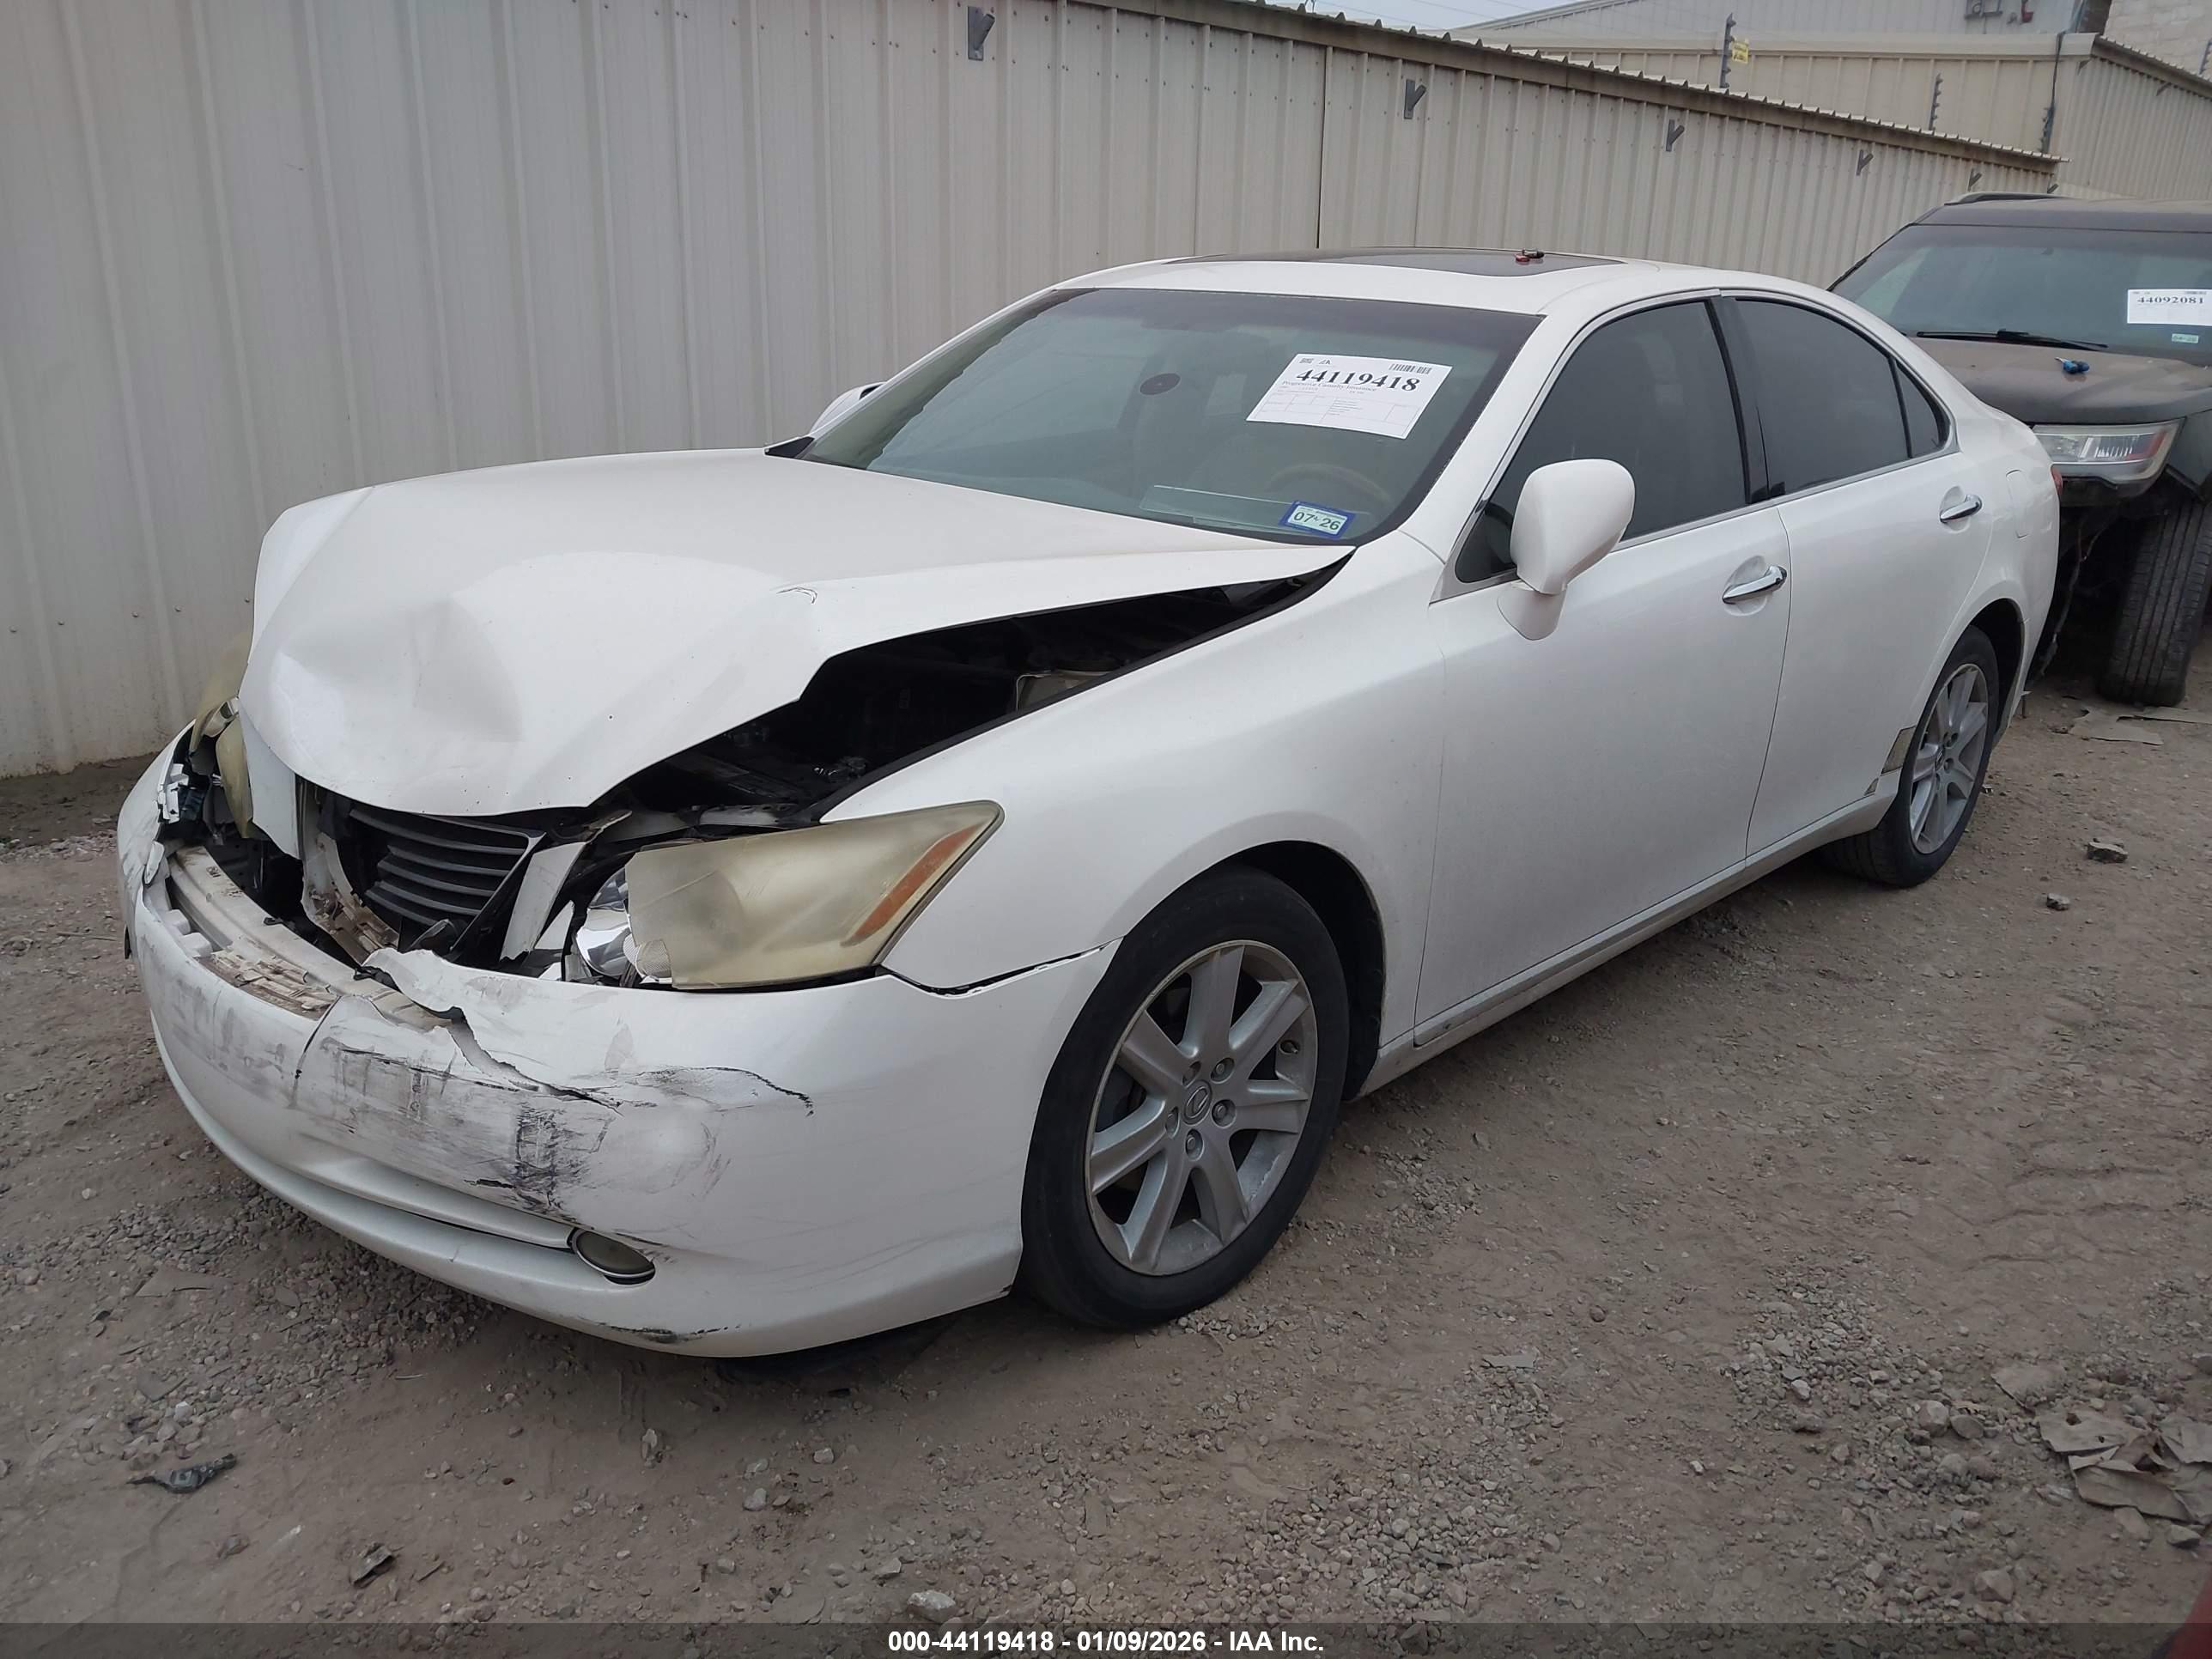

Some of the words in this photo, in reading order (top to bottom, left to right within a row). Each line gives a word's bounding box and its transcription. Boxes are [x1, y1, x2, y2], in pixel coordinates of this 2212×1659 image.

[1296, 369, 1420, 392] 44119418
[1293, 512, 1315, 523] 07
[1319, 518, 1341, 531] 26
